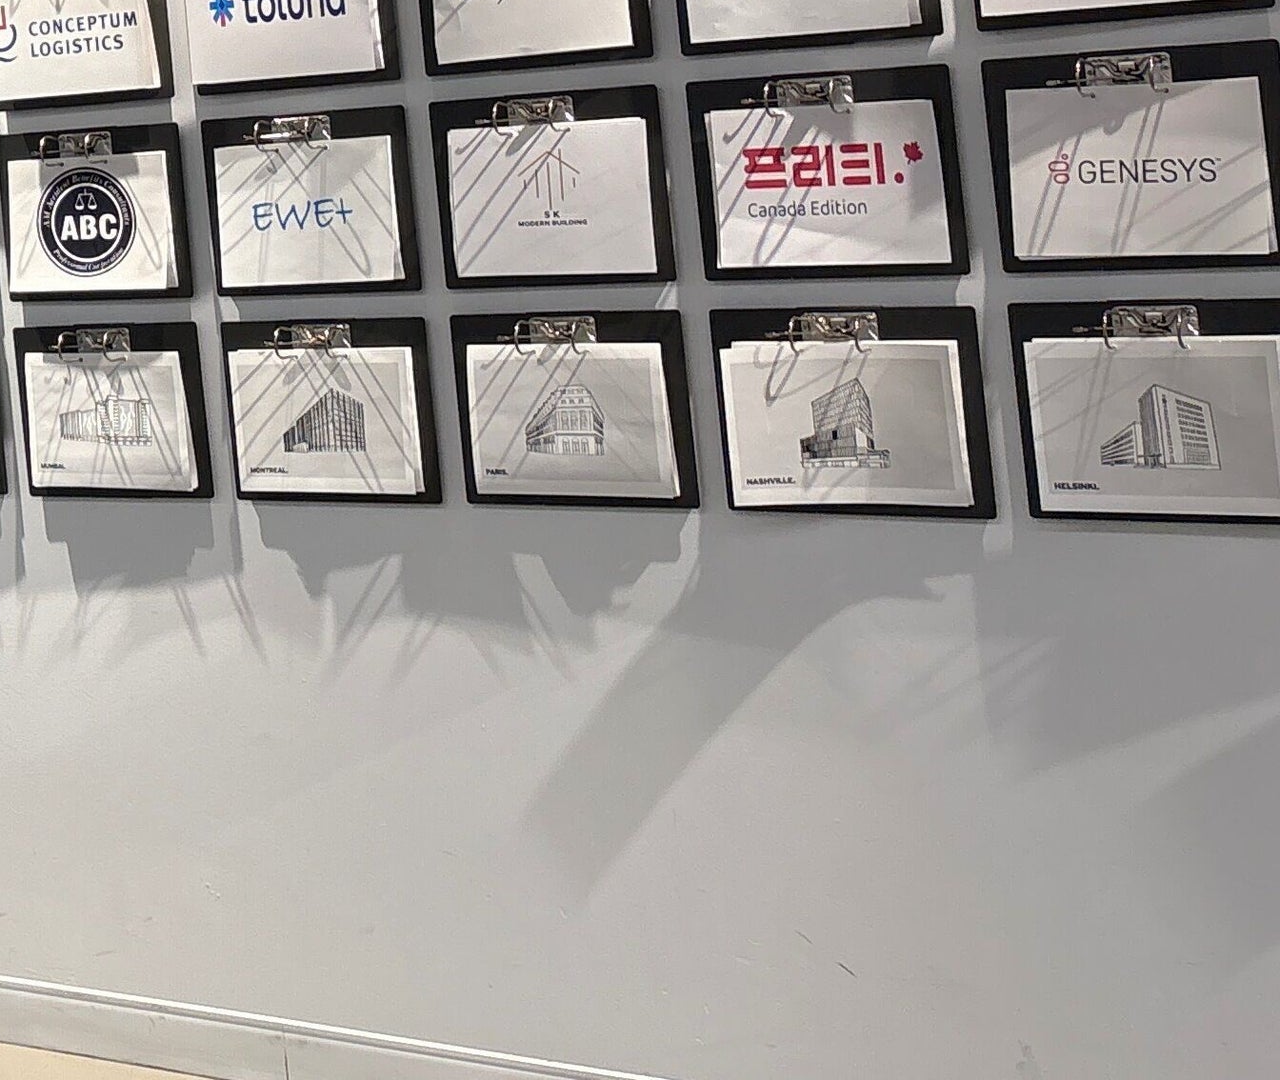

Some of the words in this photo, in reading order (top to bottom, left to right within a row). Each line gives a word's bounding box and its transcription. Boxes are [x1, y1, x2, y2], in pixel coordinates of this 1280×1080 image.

[28, 10, 138, 37] CONCEPTUM
[30, 34, 124, 58] LOGISTICS
[1078, 157, 1217, 185] GENESYS
[747, 200, 807, 218] Canada
[810, 199, 868, 216] Edition
[60, 213, 118, 241] ABC
[551, 218, 588, 226] BUILDING
